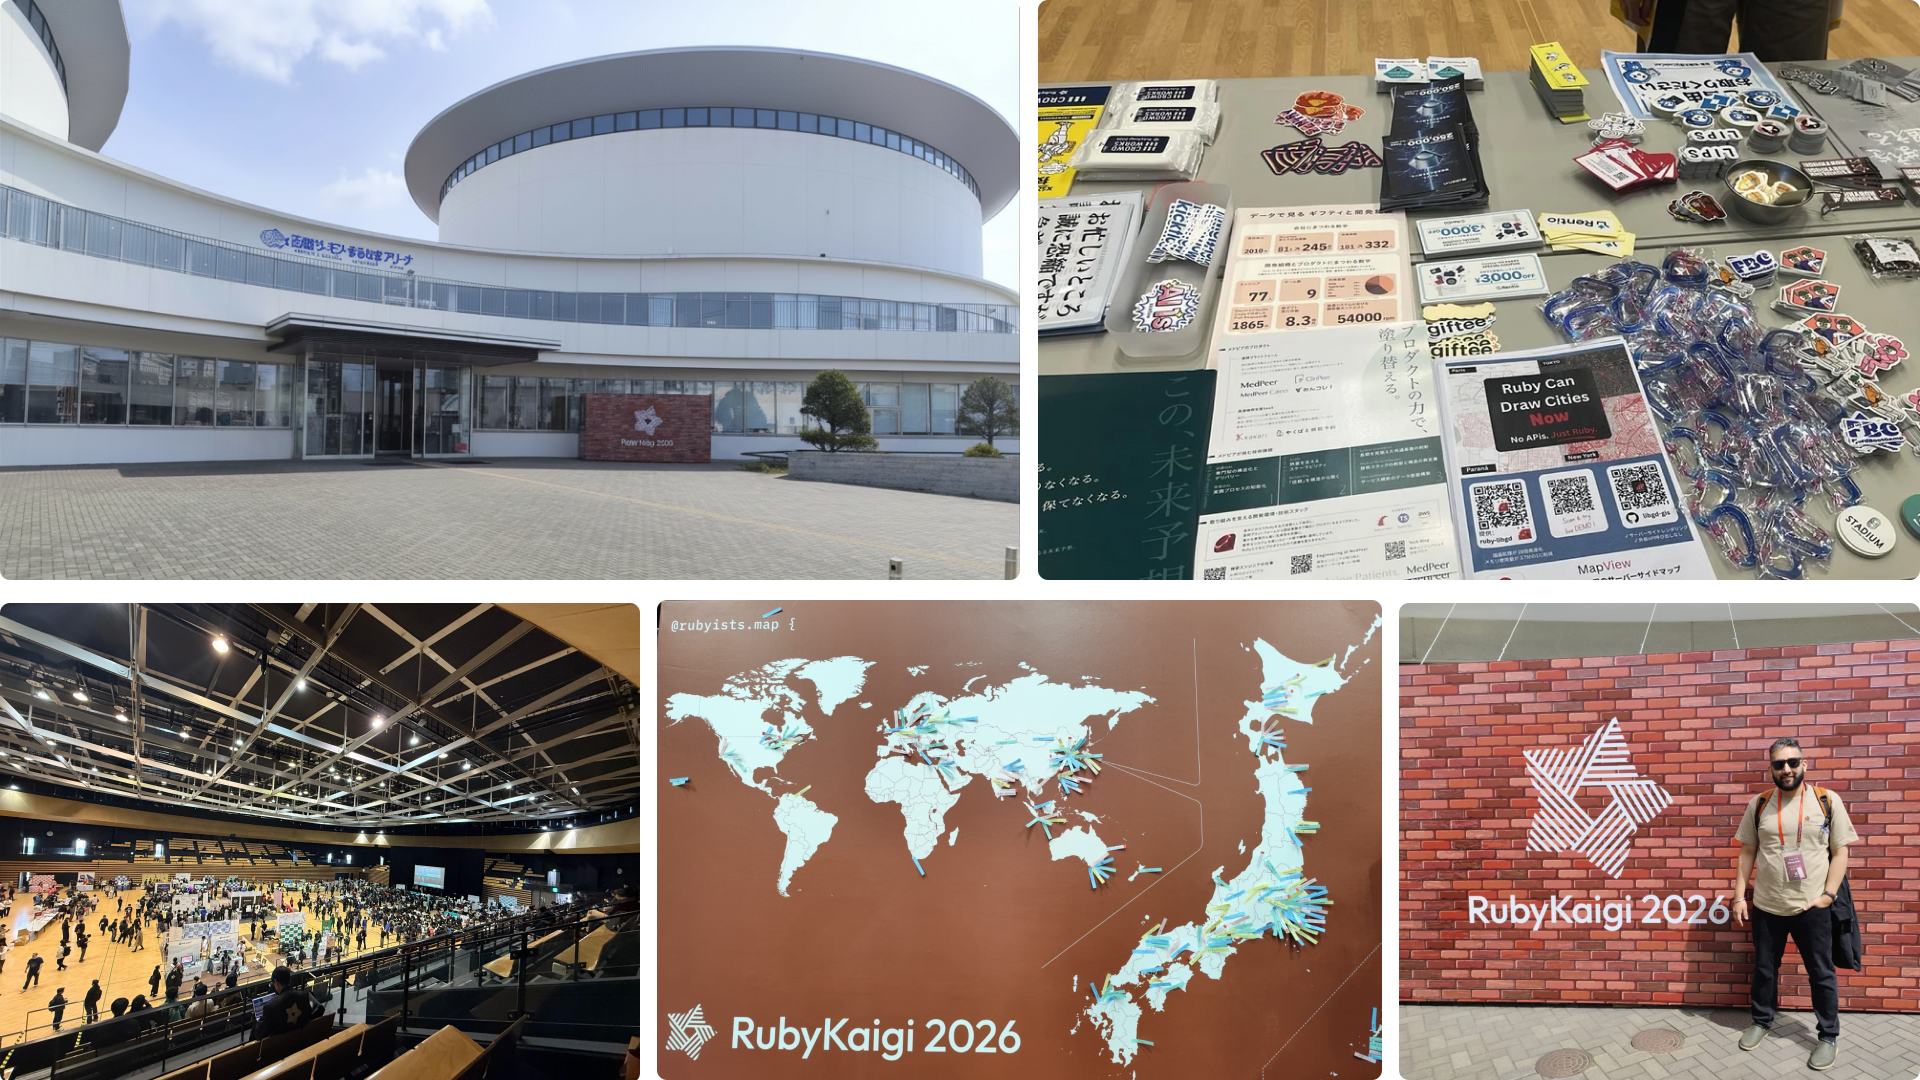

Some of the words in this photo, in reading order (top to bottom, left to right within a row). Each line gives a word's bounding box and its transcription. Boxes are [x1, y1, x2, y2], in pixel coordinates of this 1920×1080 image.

[1638, 77, 1752, 92] お取りください
[1694, 130, 1739, 140] LIPS
[1687, 148, 1737, 159] LIPS
[1250, 211, 1305, 219] データで見る
[1547, 218, 1594, 227] Rentio
[1056, 212, 1111, 317] お忙しいところ
[1732, 253, 1773, 273] FBC
[1249, 292, 1269, 302] 77
[1307, 289, 1317, 299] 9
[1232, 321, 1265, 330] 1865
[1286, 316, 1311, 327] 8.3
[1338, 313, 1382, 324] 54000
[1428, 318, 1487, 337] giftee
[1431, 343, 1493, 359] giftee
[1378, 328, 1401, 400] 塗り替える。
[1240, 380, 1278, 389] MedPeer
[1402, 324, 1428, 434] プロダクトの力で、
[1502, 381, 1541, 394] Ruby
[1545, 377, 1576, 389] Can
[1500, 399, 1541, 413] Draw
[1545, 393, 1590, 407] Cities
[1529, 412, 1570, 426] Now
[1510, 436, 1525, 444] No
[1551, 430, 1571, 438] Just
[1572, 426, 1598, 436] Ruby.
[1466, 465, 1489, 473] Paraná
[1043, 490, 1129, 512] 保てなくなる。
[1562, 517, 1576, 525] Scan
[1643, 510, 1671, 520] libgd-gis
[1575, 524, 1592, 532] DEMO
[1845, 515, 1885, 549] STADIUM
[1480, 536, 1513, 545] ruby-libgd
[1407, 562, 1450, 574] MedPeer
[1578, 560, 1632, 575] MapView
[671, 619, 779, 633] @rubyists.map
[789, 618, 796, 631] {
[1468, 894, 1632, 932] RubyKaigi
[1641, 894, 1730, 925] 2026
[732, 1017, 914, 1062] RubyKaigi
[924, 1019, 1022, 1054] 2026
